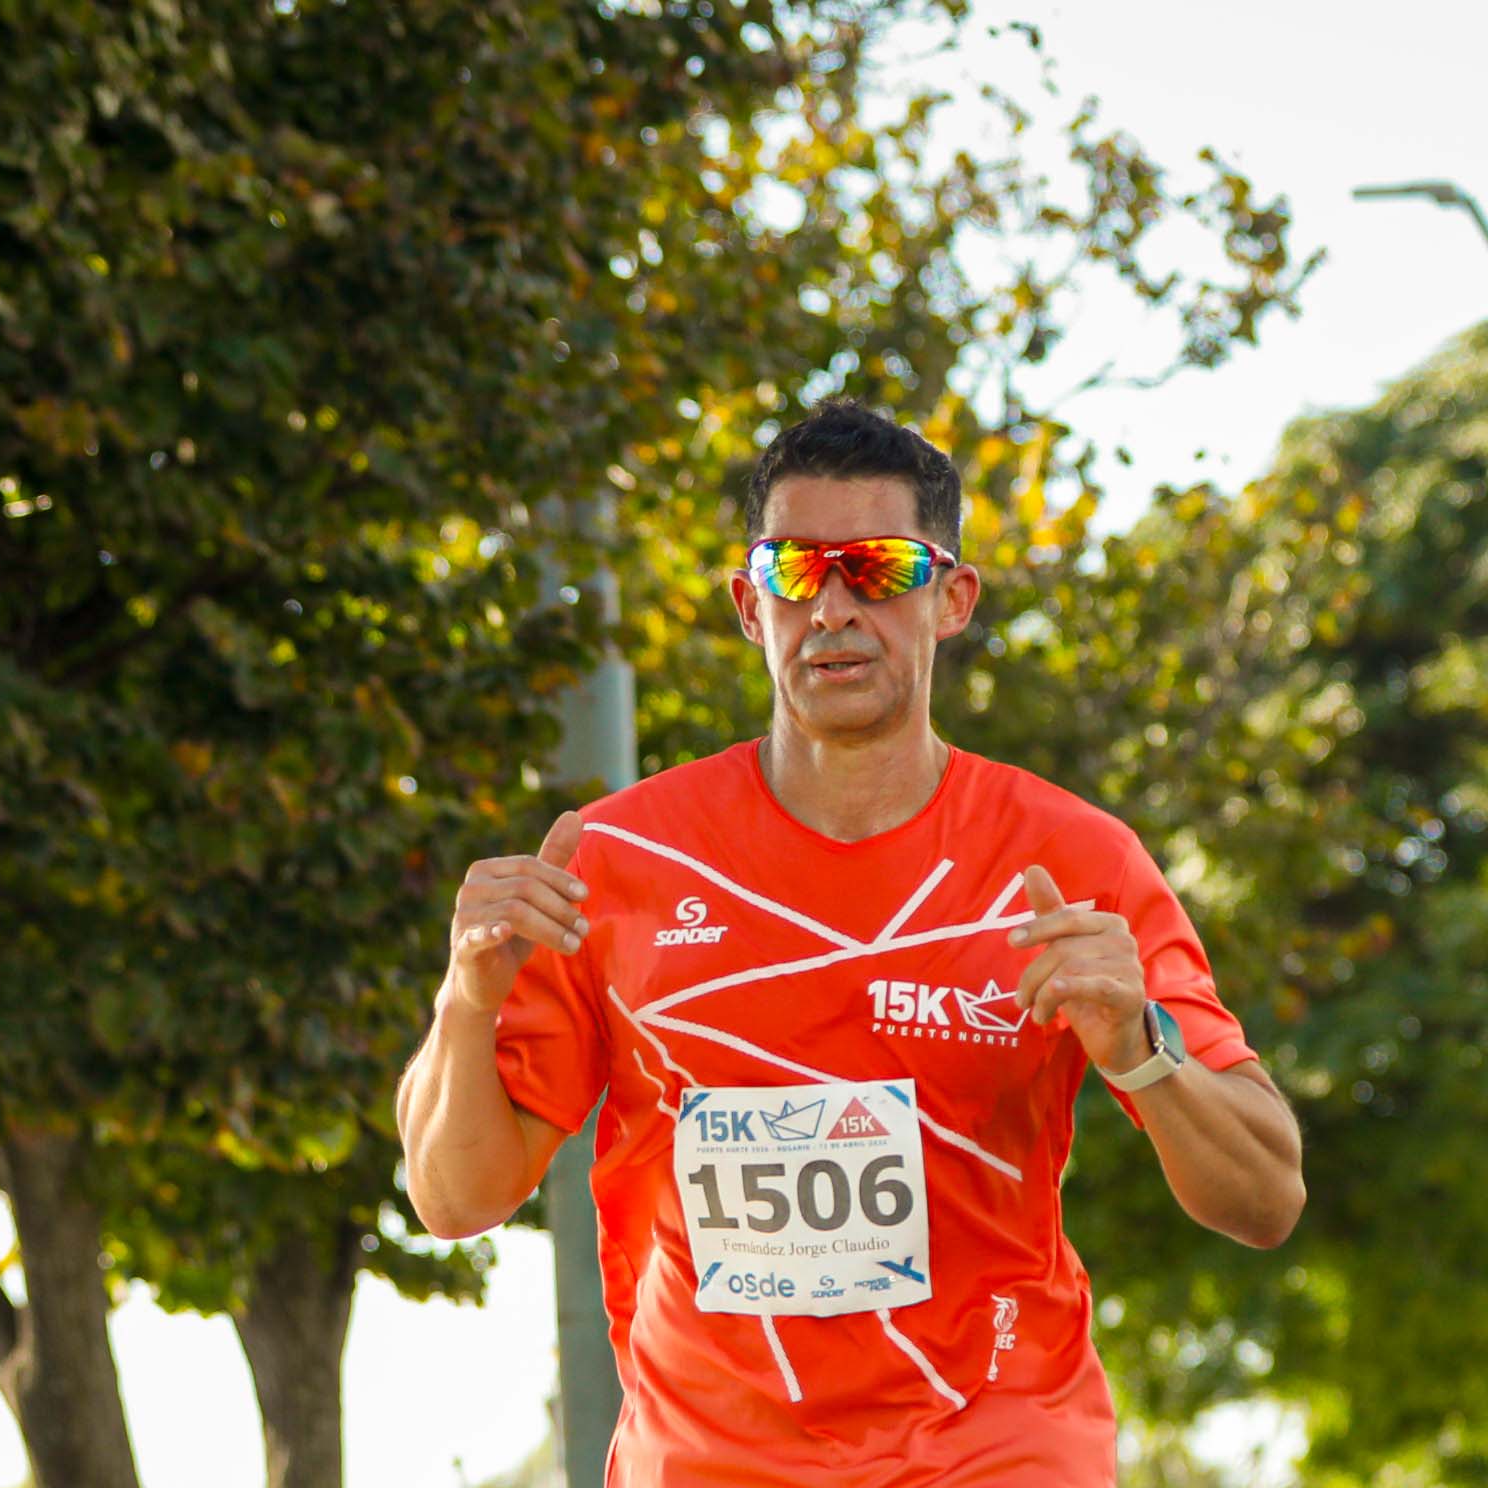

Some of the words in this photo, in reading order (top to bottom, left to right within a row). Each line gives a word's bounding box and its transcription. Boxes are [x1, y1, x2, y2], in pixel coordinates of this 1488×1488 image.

[867, 979, 952, 1026] 15K
[872, 1022, 951, 1040] PUERTO
[958, 1031, 1019, 1048] NORTE
[695, 1110, 757, 1142] 15K
[839, 1114, 876, 1135] 15K
[687, 1154, 914, 1234] 1506
[722, 1238, 786, 1257] Fernández
[789, 1241, 827, 1258] Jorge
[832, 1236, 890, 1252] Claudio
[727, 1271, 796, 1299] osde
